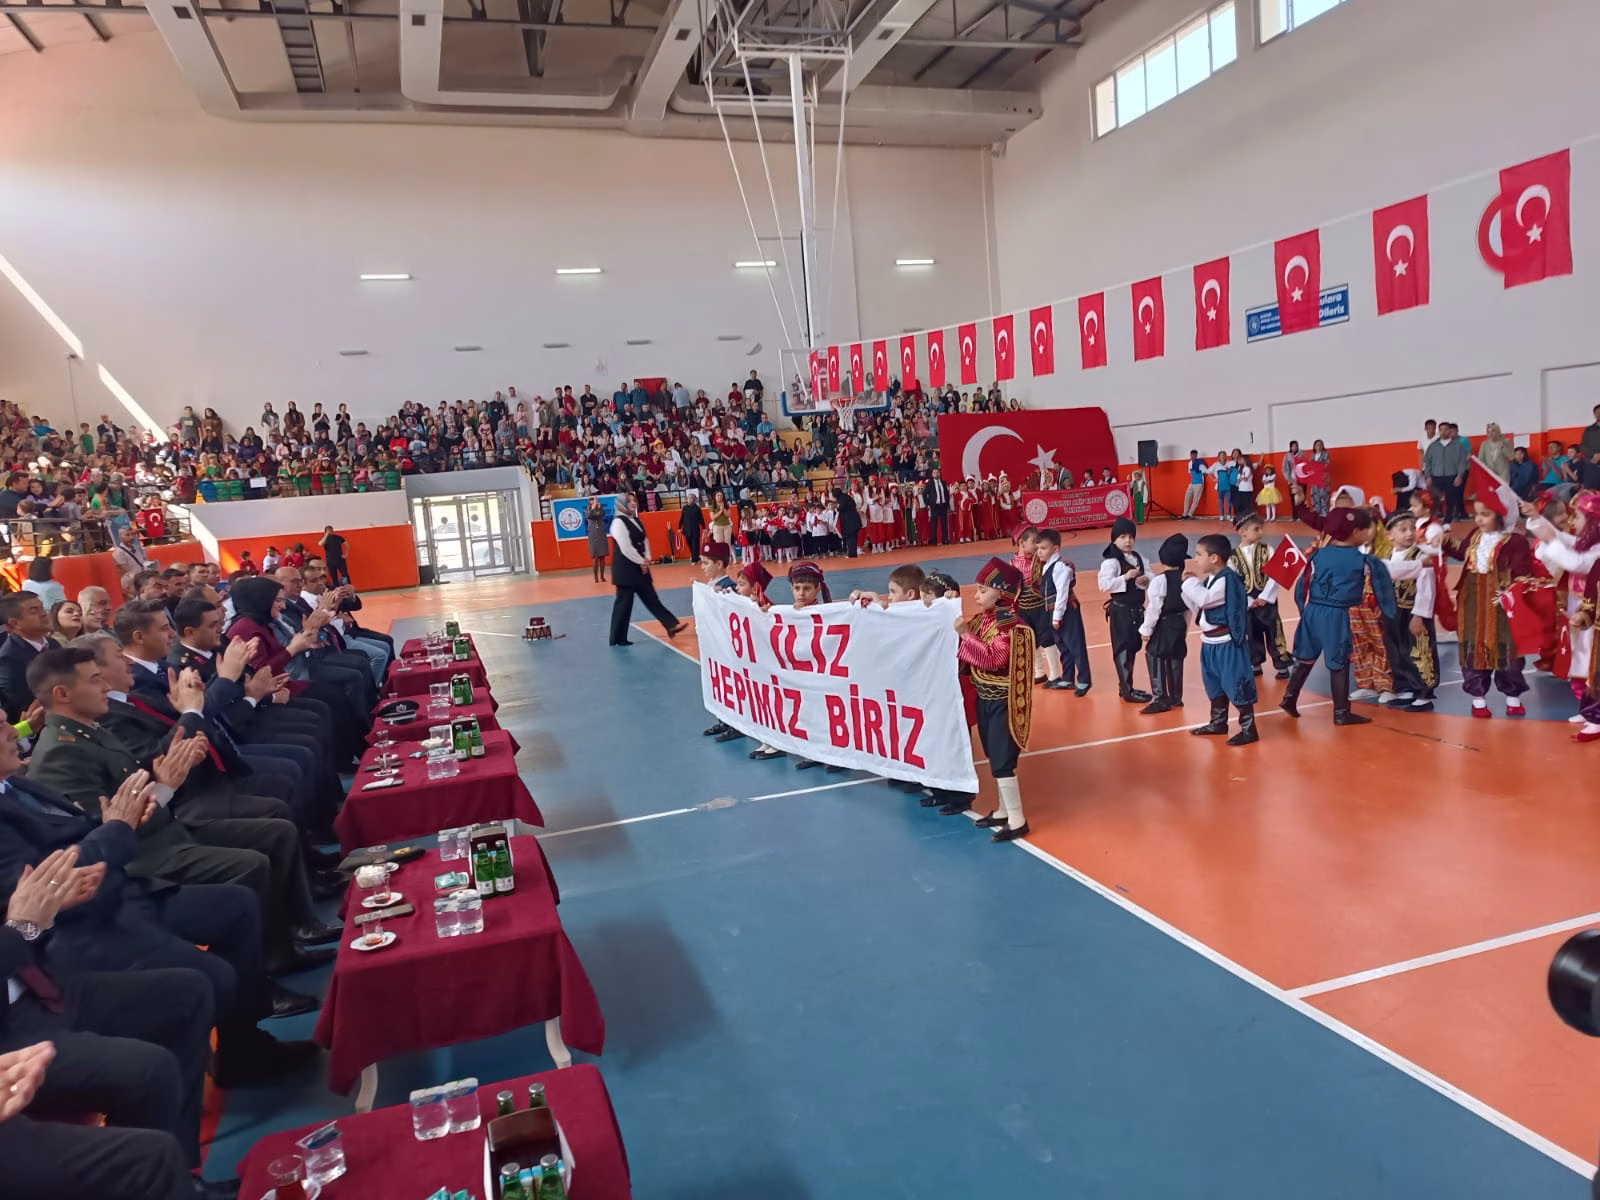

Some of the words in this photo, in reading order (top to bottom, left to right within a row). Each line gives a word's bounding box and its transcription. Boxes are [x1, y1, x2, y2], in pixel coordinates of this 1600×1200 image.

[728, 612, 757, 664] 81
[769, 613, 851, 678] İLİZ
[708, 657, 809, 741] HEPİMİZ
[824, 683, 926, 770] BİRİZ
